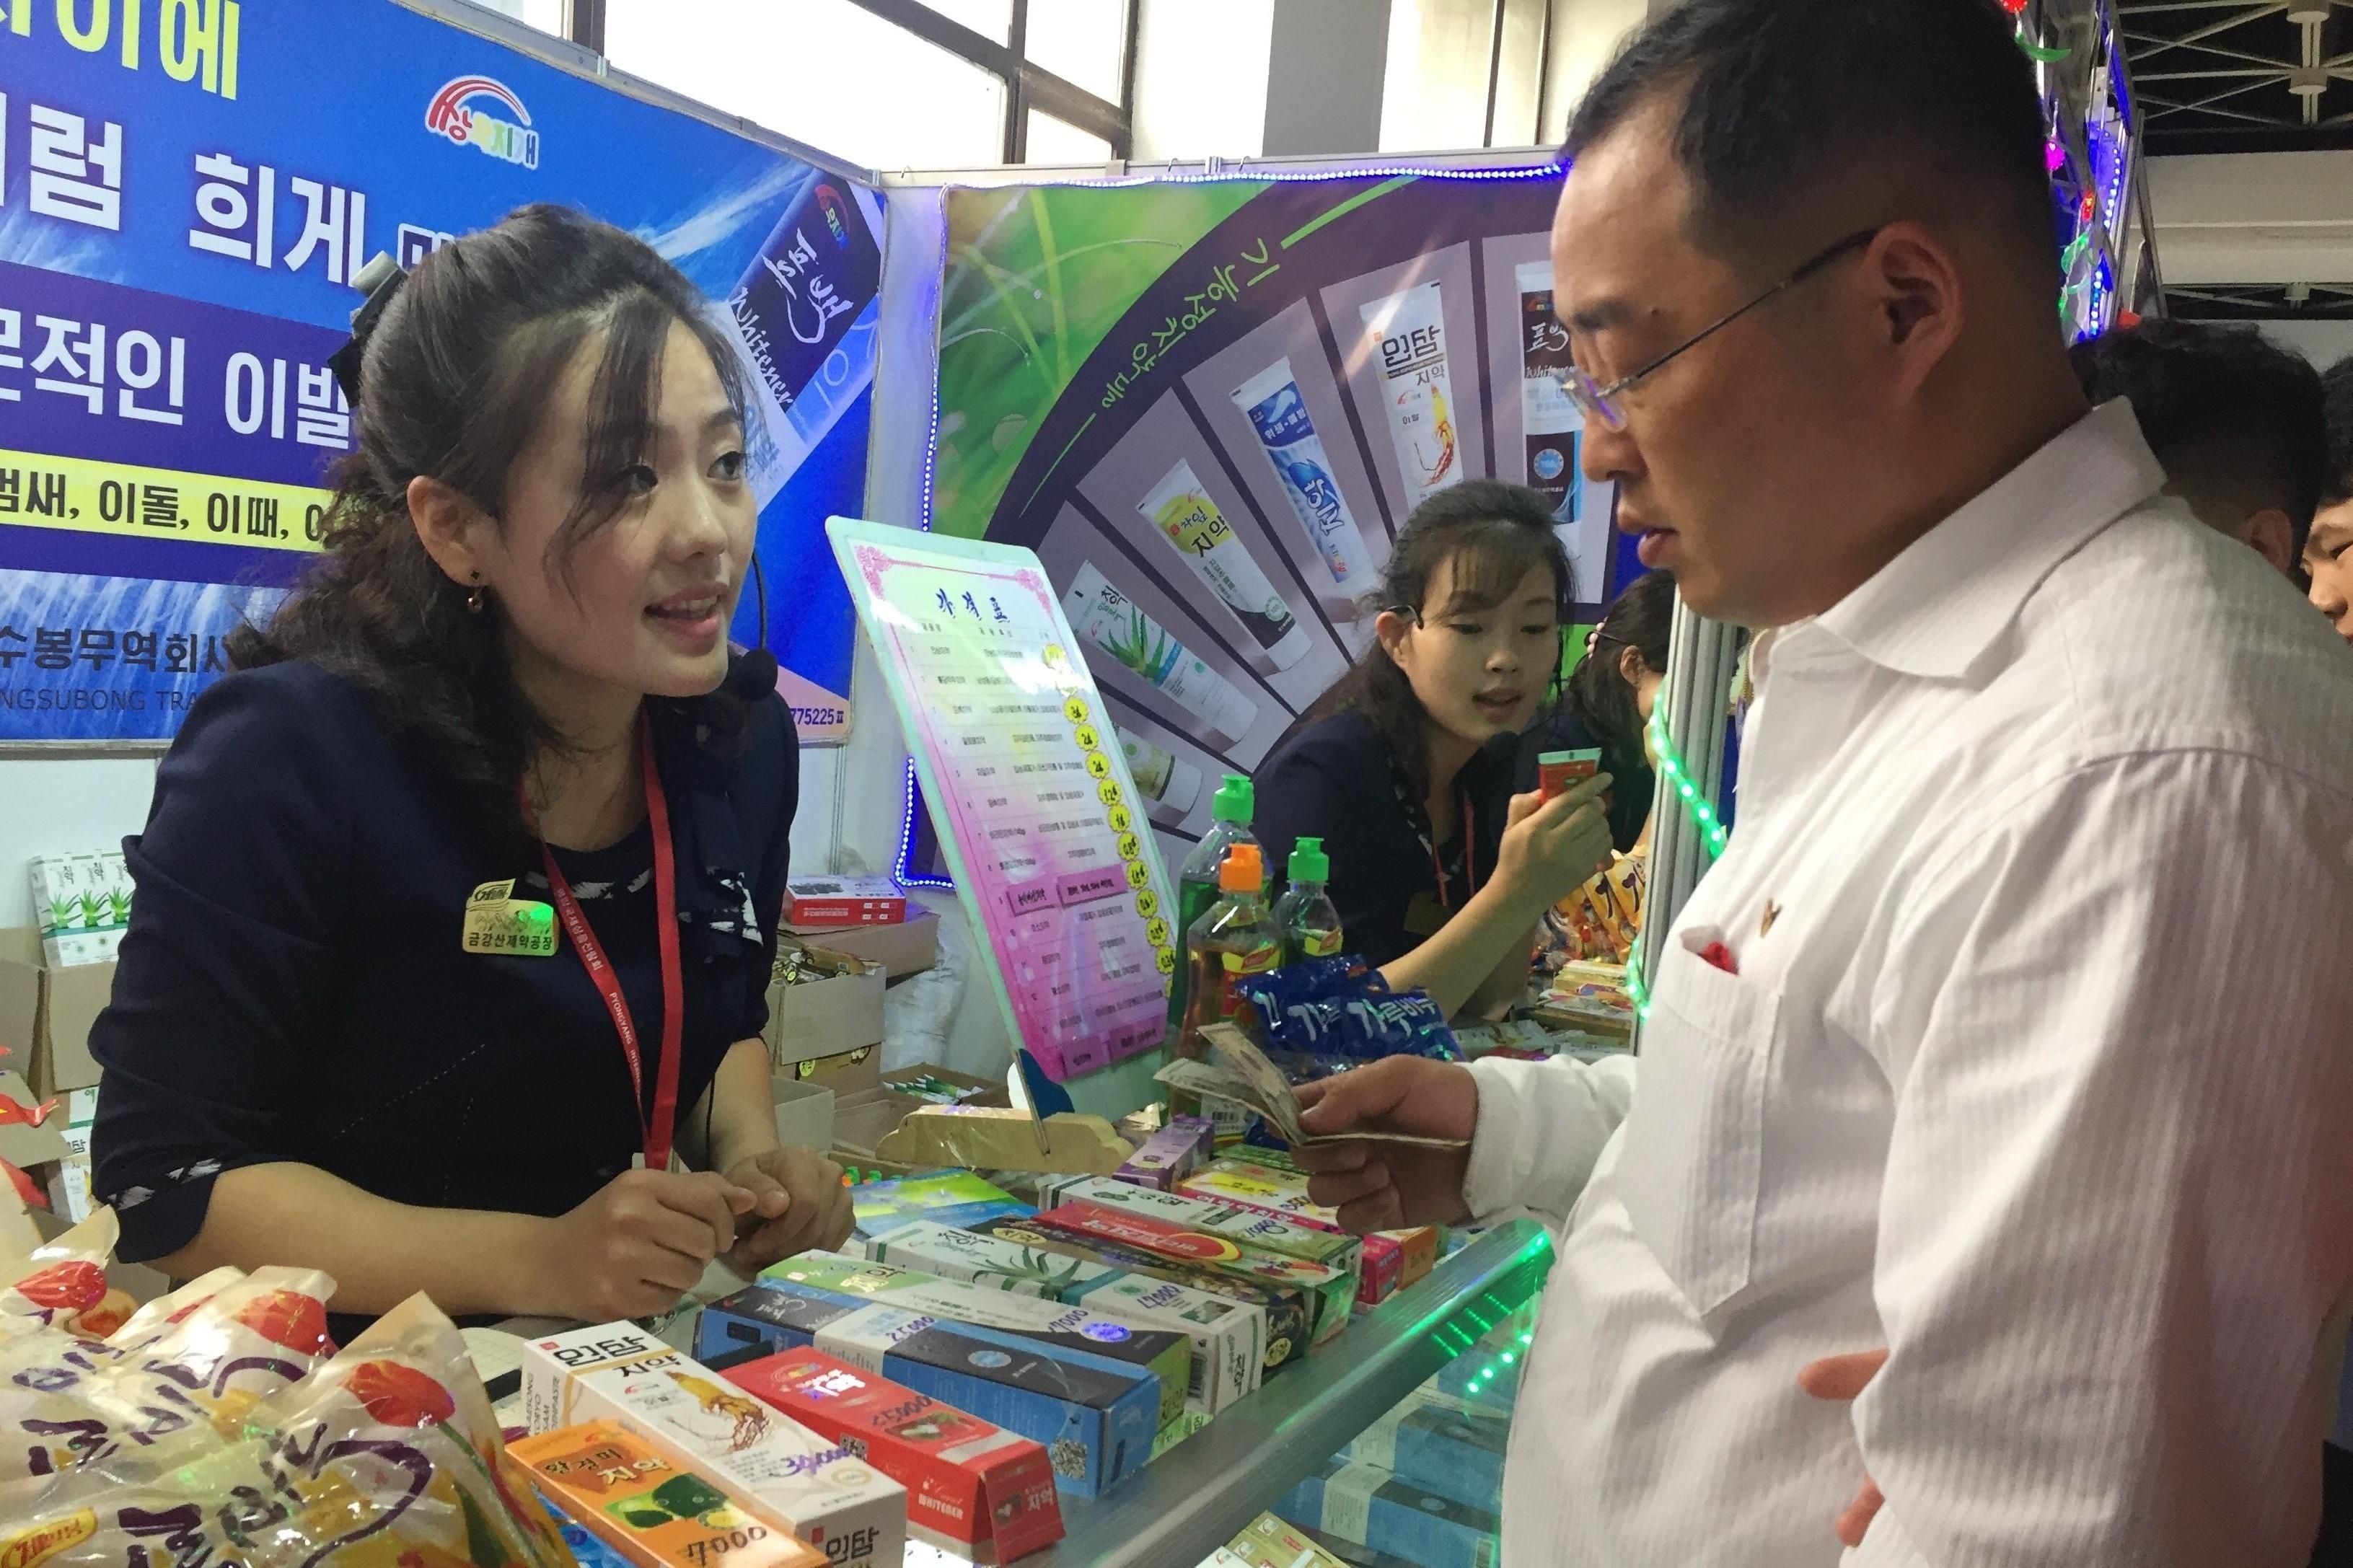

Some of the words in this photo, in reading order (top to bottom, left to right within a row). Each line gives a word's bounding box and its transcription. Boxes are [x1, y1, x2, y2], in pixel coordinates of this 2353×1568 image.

[189, 153, 366, 287] 희게
[729, 286, 793, 406] Whitener
[99, 480, 189, 531] 이돌,
[608, 992, 633, 1044] PYONGYANG
[918, 1492, 964, 1520] WHITENER
